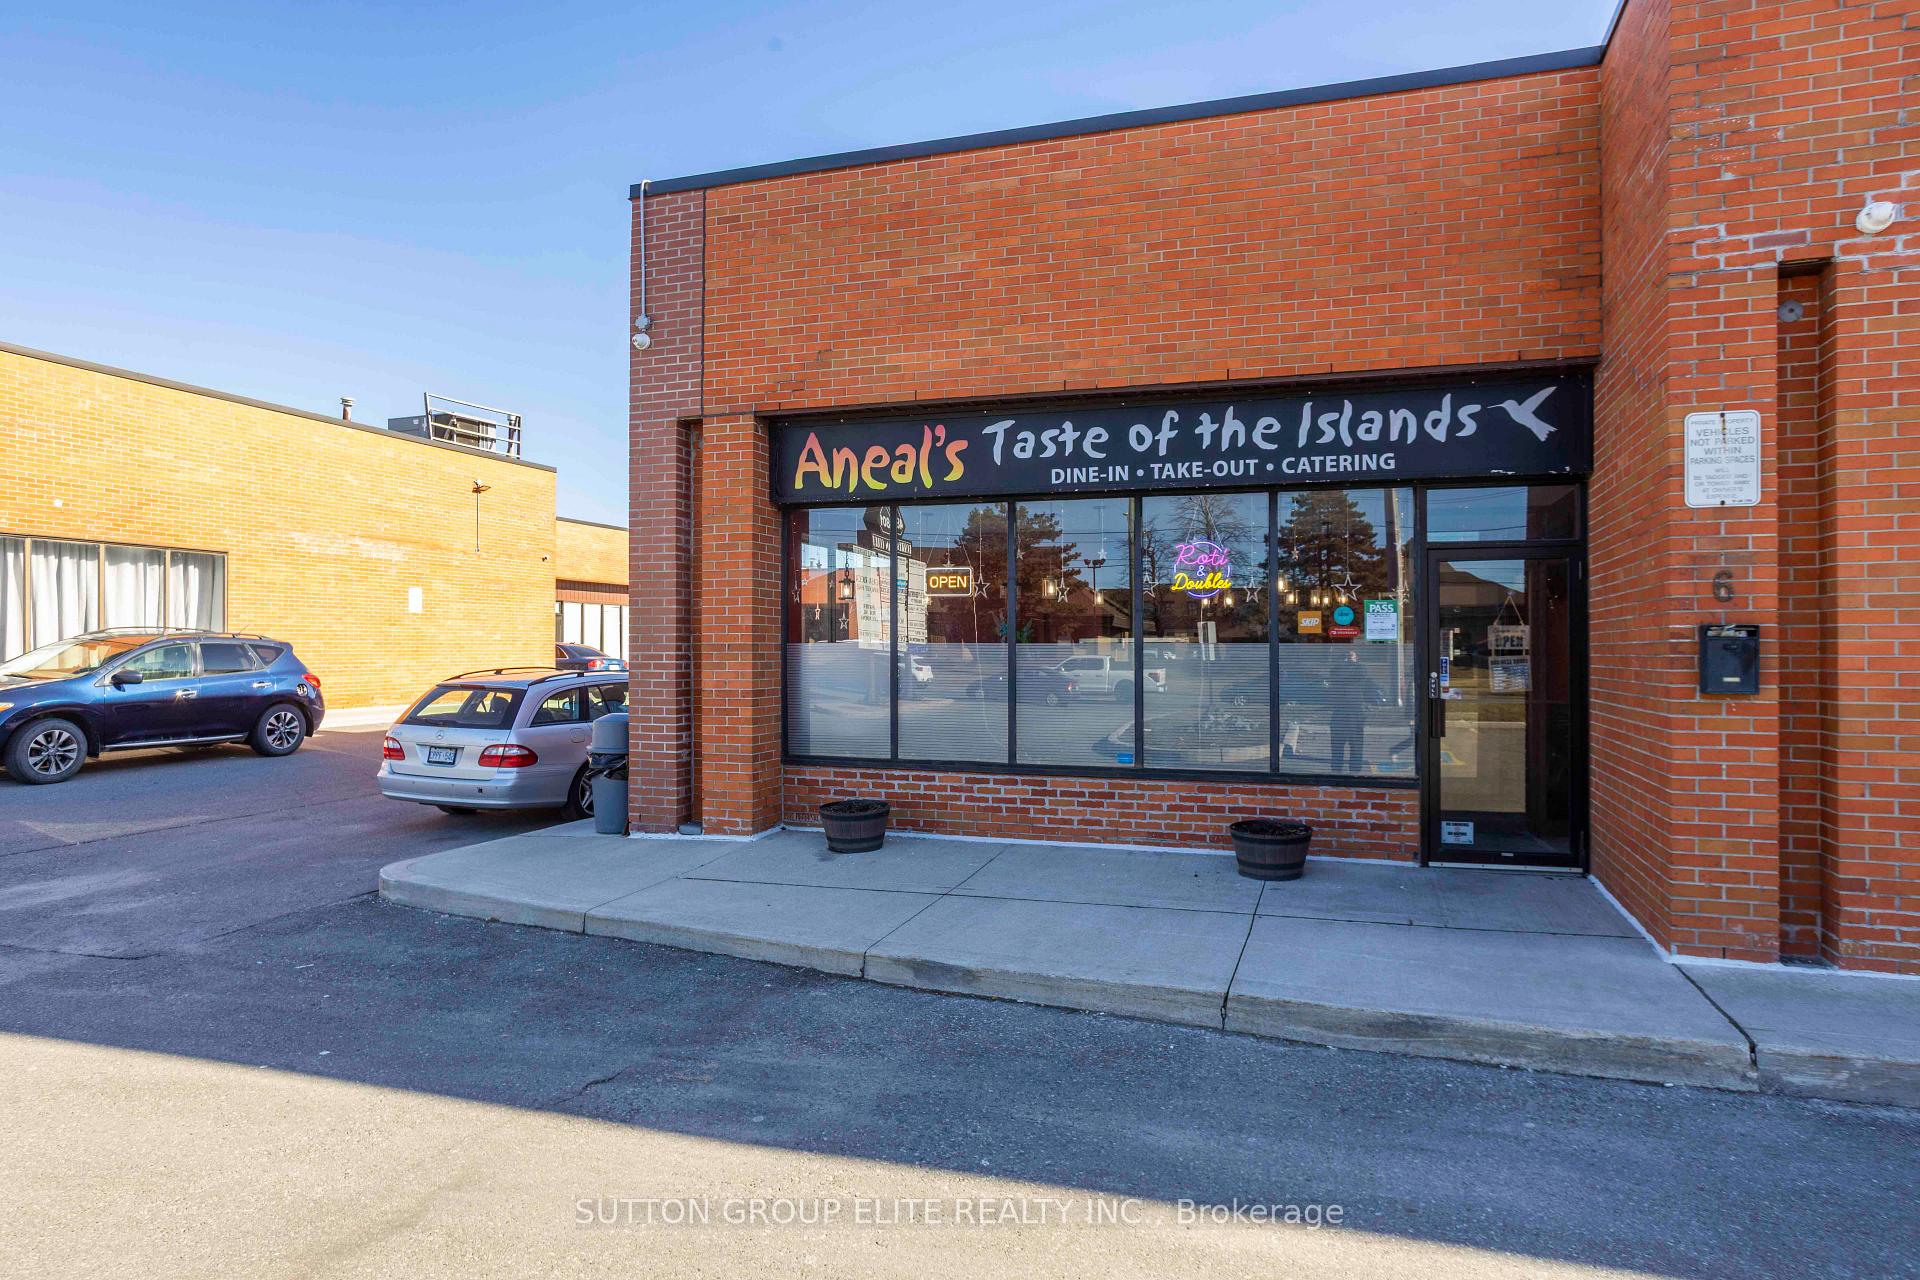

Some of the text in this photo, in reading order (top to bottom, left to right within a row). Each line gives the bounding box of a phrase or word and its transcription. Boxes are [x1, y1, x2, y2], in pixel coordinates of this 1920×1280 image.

[1696, 427, 1749, 436] VEHILES
[795, 393, 1481, 493] Aneal's Taste of the Islands
[1691, 438, 1709, 446] NOT
[1704, 447, 1741, 455] WITHIN
[1690, 455, 1755, 465] PARKING SPACES
[1051, 452, 1396, 485] DINE-IN TAKE-OUT CATERING
[1175, 544, 1228, 566] Roti
[1196, 565, 1205, 577] &
[929, 575, 967, 588] OPEN
[1171, 571, 1231, 590] Doubles
[1713, 570, 1734, 602] 6
[1369, 604, 1394, 613] PASS
[1302, 617, 1319, 626] SKIP
